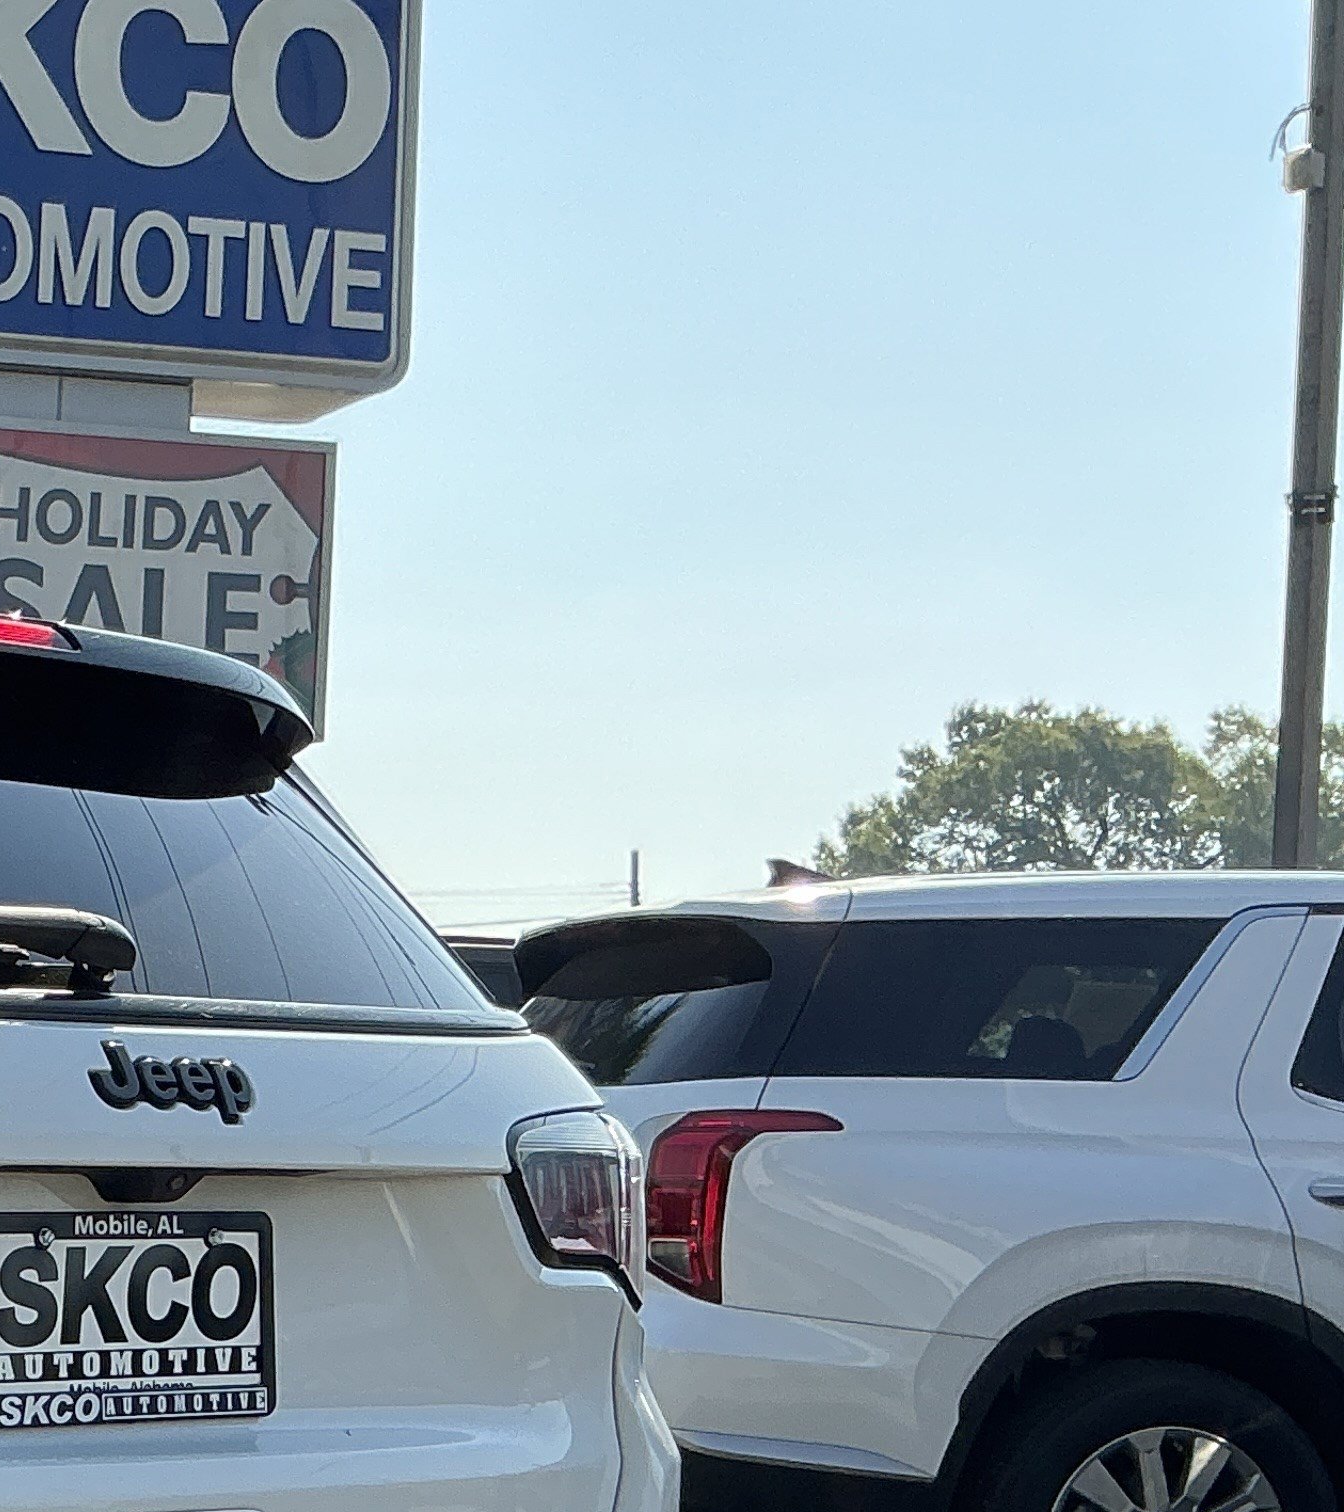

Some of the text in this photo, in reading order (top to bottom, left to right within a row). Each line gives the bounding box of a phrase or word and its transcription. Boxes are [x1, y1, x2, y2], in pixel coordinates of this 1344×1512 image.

[86, 1038, 256, 1127] Jeep
[73, 1215, 184, 1236] Mobile, AL
[105, 1390, 266, 1418] AUTOMOTIVE
